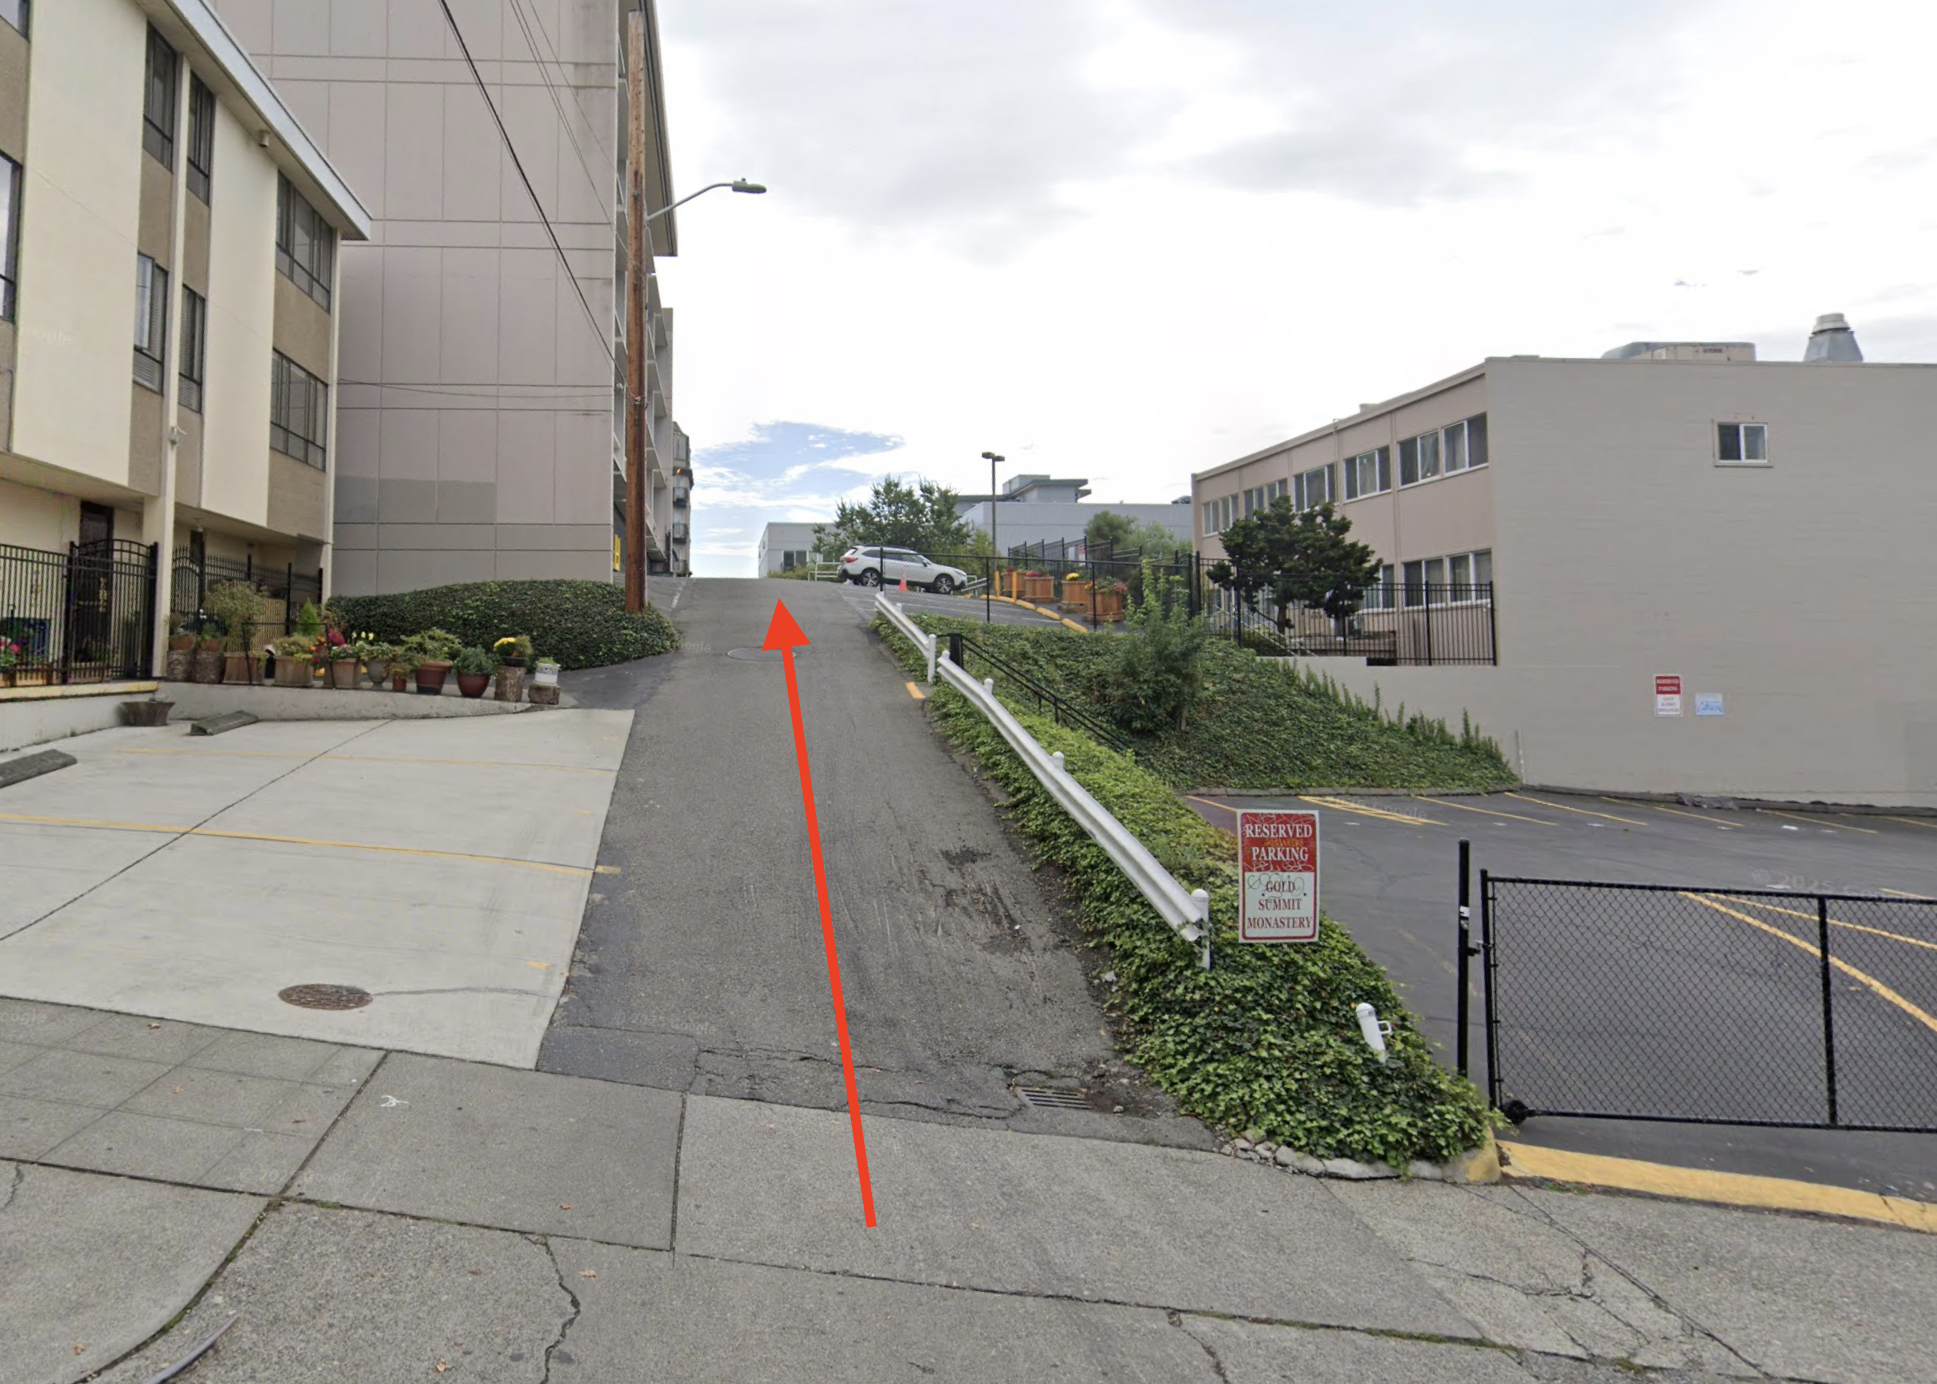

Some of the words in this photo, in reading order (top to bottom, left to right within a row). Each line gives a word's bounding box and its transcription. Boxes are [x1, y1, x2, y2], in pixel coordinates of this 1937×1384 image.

[1245, 823, 1313, 838] RESERVED
[1251, 846, 1309, 861] PARKING
[1266, 880, 1296, 893] GOLD
[1258, 898, 1302, 911] SUMMIT
[1247, 917, 1313, 929] MONASTERY
